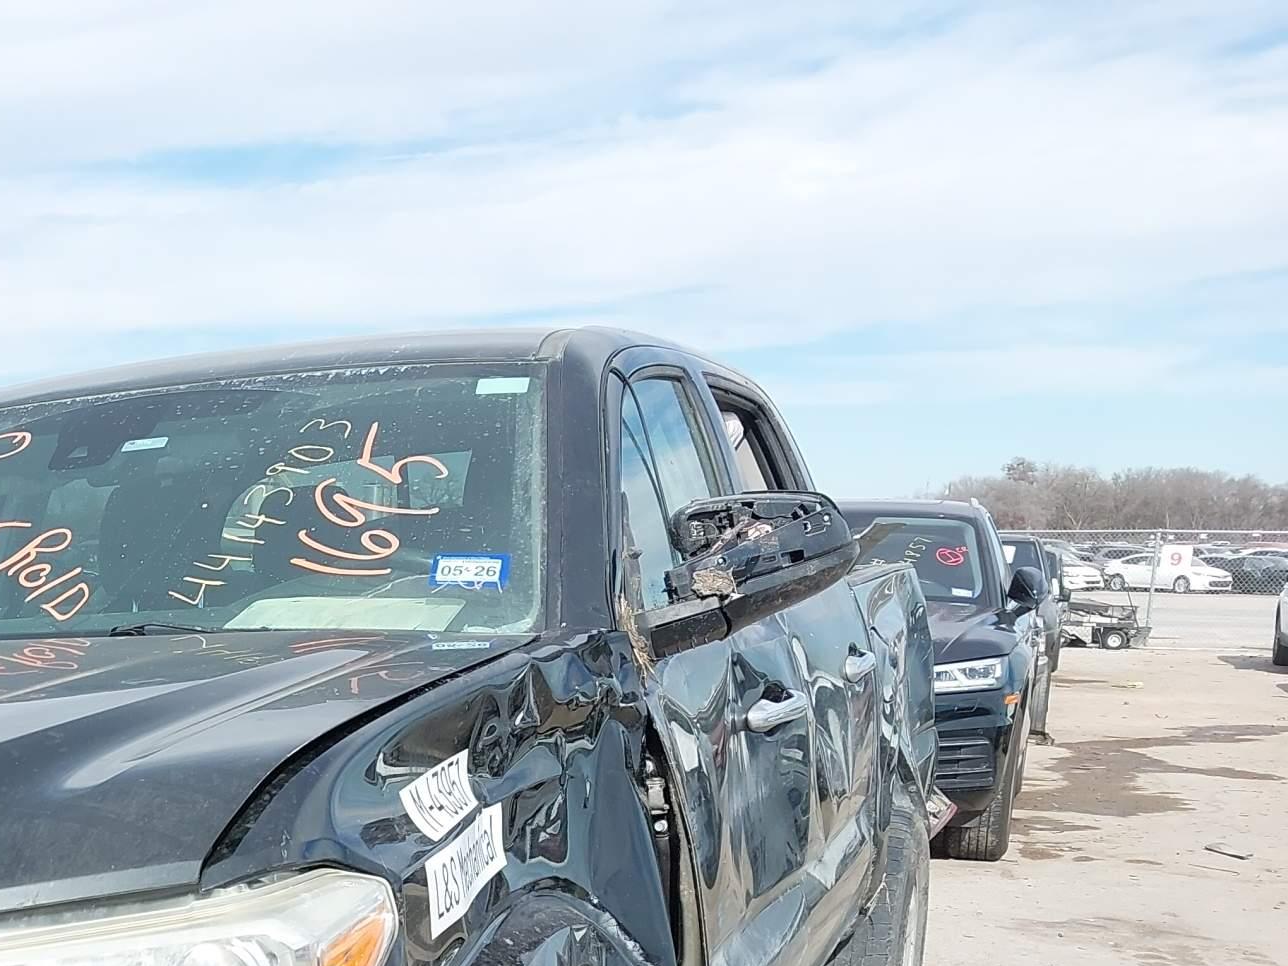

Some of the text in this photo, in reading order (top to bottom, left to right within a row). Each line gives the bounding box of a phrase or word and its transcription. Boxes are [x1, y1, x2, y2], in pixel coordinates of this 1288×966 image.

[168, 418, 352, 605] 44143903
[474, 565, 497, 577] 26
[1170, 552, 1182, 566] 9
[434, 815, 498, 919] L&S Mechanical
